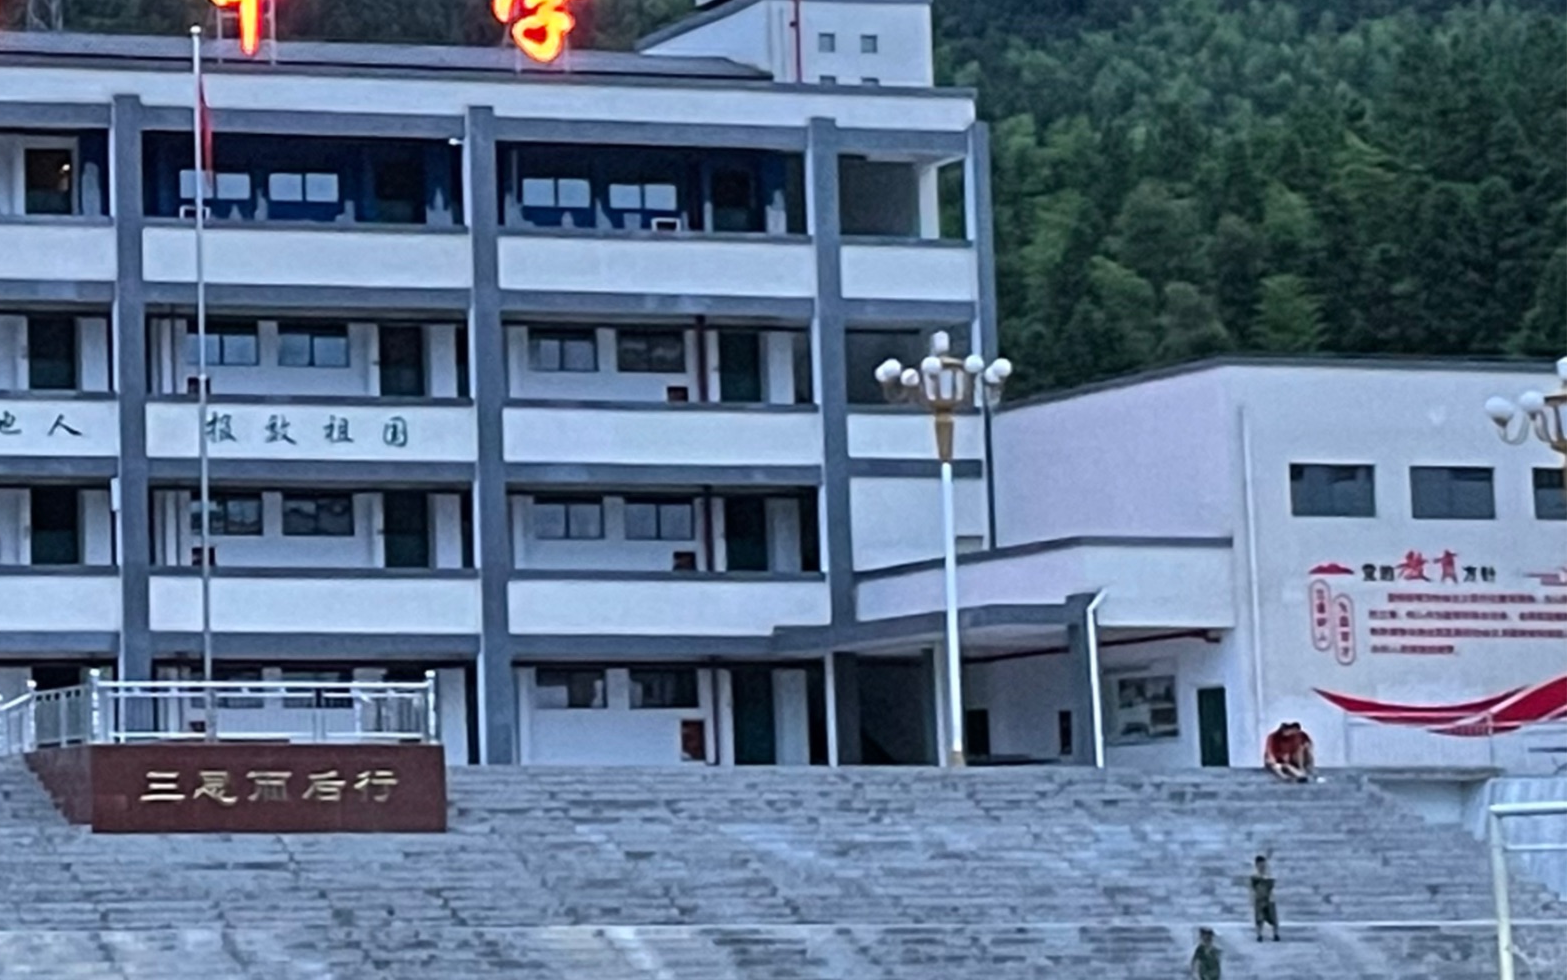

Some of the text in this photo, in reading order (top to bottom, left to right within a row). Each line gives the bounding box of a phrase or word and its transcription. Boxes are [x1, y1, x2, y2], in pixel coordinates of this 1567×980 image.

[139, 770, 399, 804] 三思而后行
